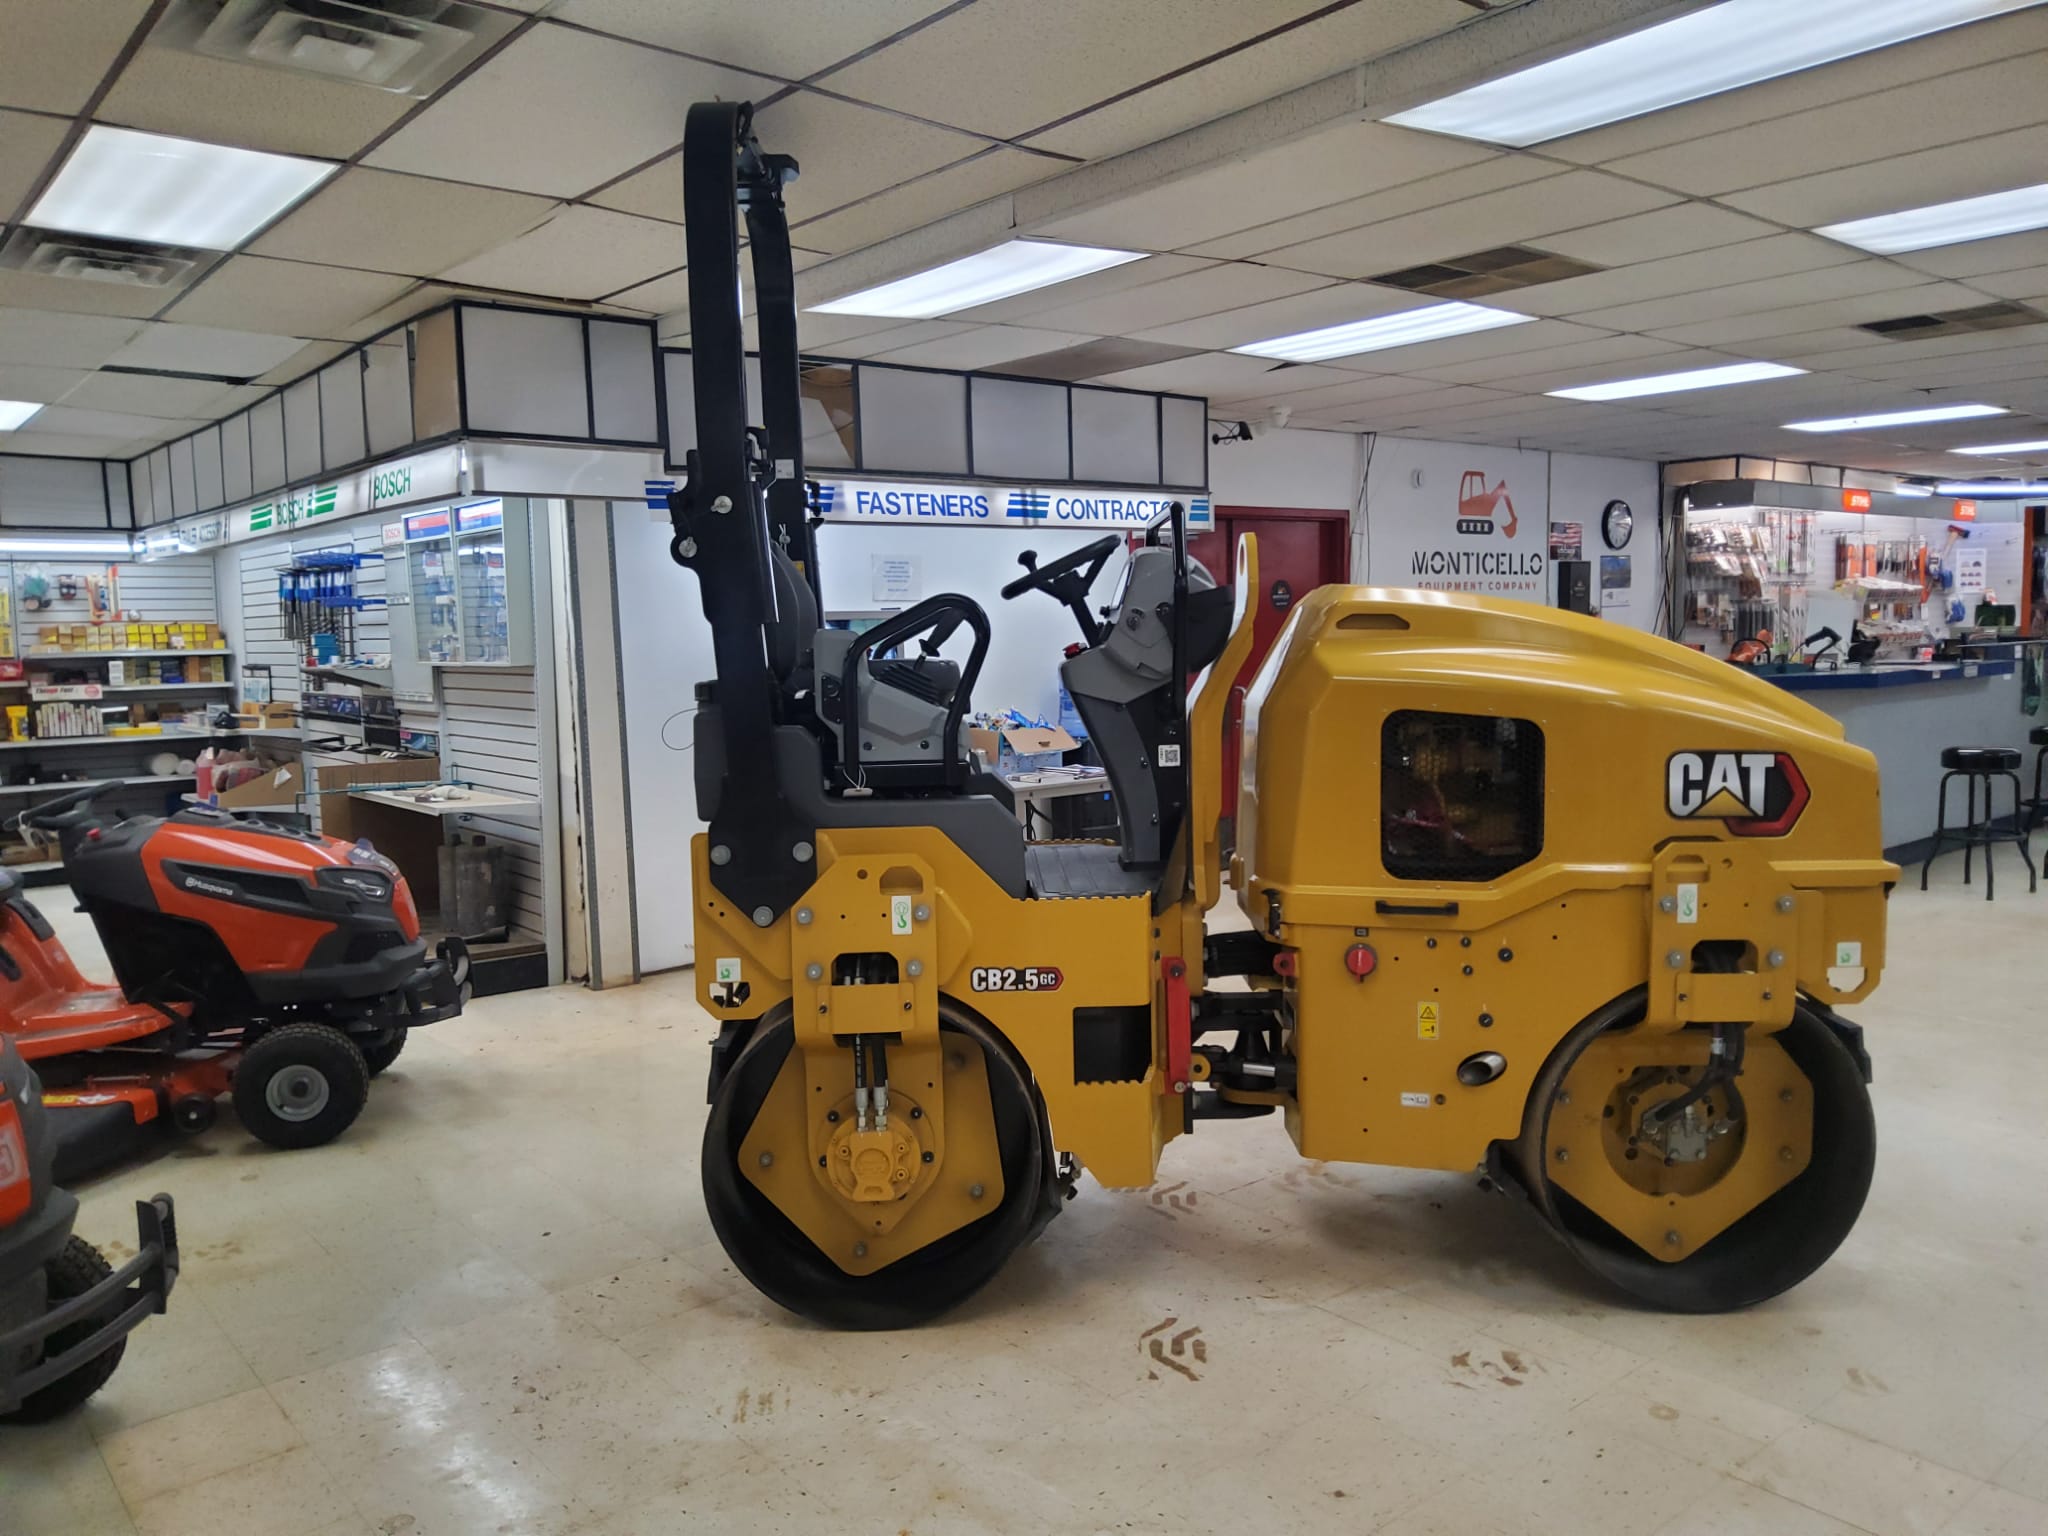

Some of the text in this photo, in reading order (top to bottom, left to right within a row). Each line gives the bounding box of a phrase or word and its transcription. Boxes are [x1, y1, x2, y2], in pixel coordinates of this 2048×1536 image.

[374, 466, 411, 500] BOSCH
[276, 497, 304, 525] BOSCH
[855, 490, 989, 518] FASTENERS
[1412, 551, 1543, 575] MONTICELLO
[1418, 581, 1537, 591] EQUIPMENT COMPANY
[1669, 753, 1776, 817] CAT
[972, 967, 1039, 991] CB2.5
